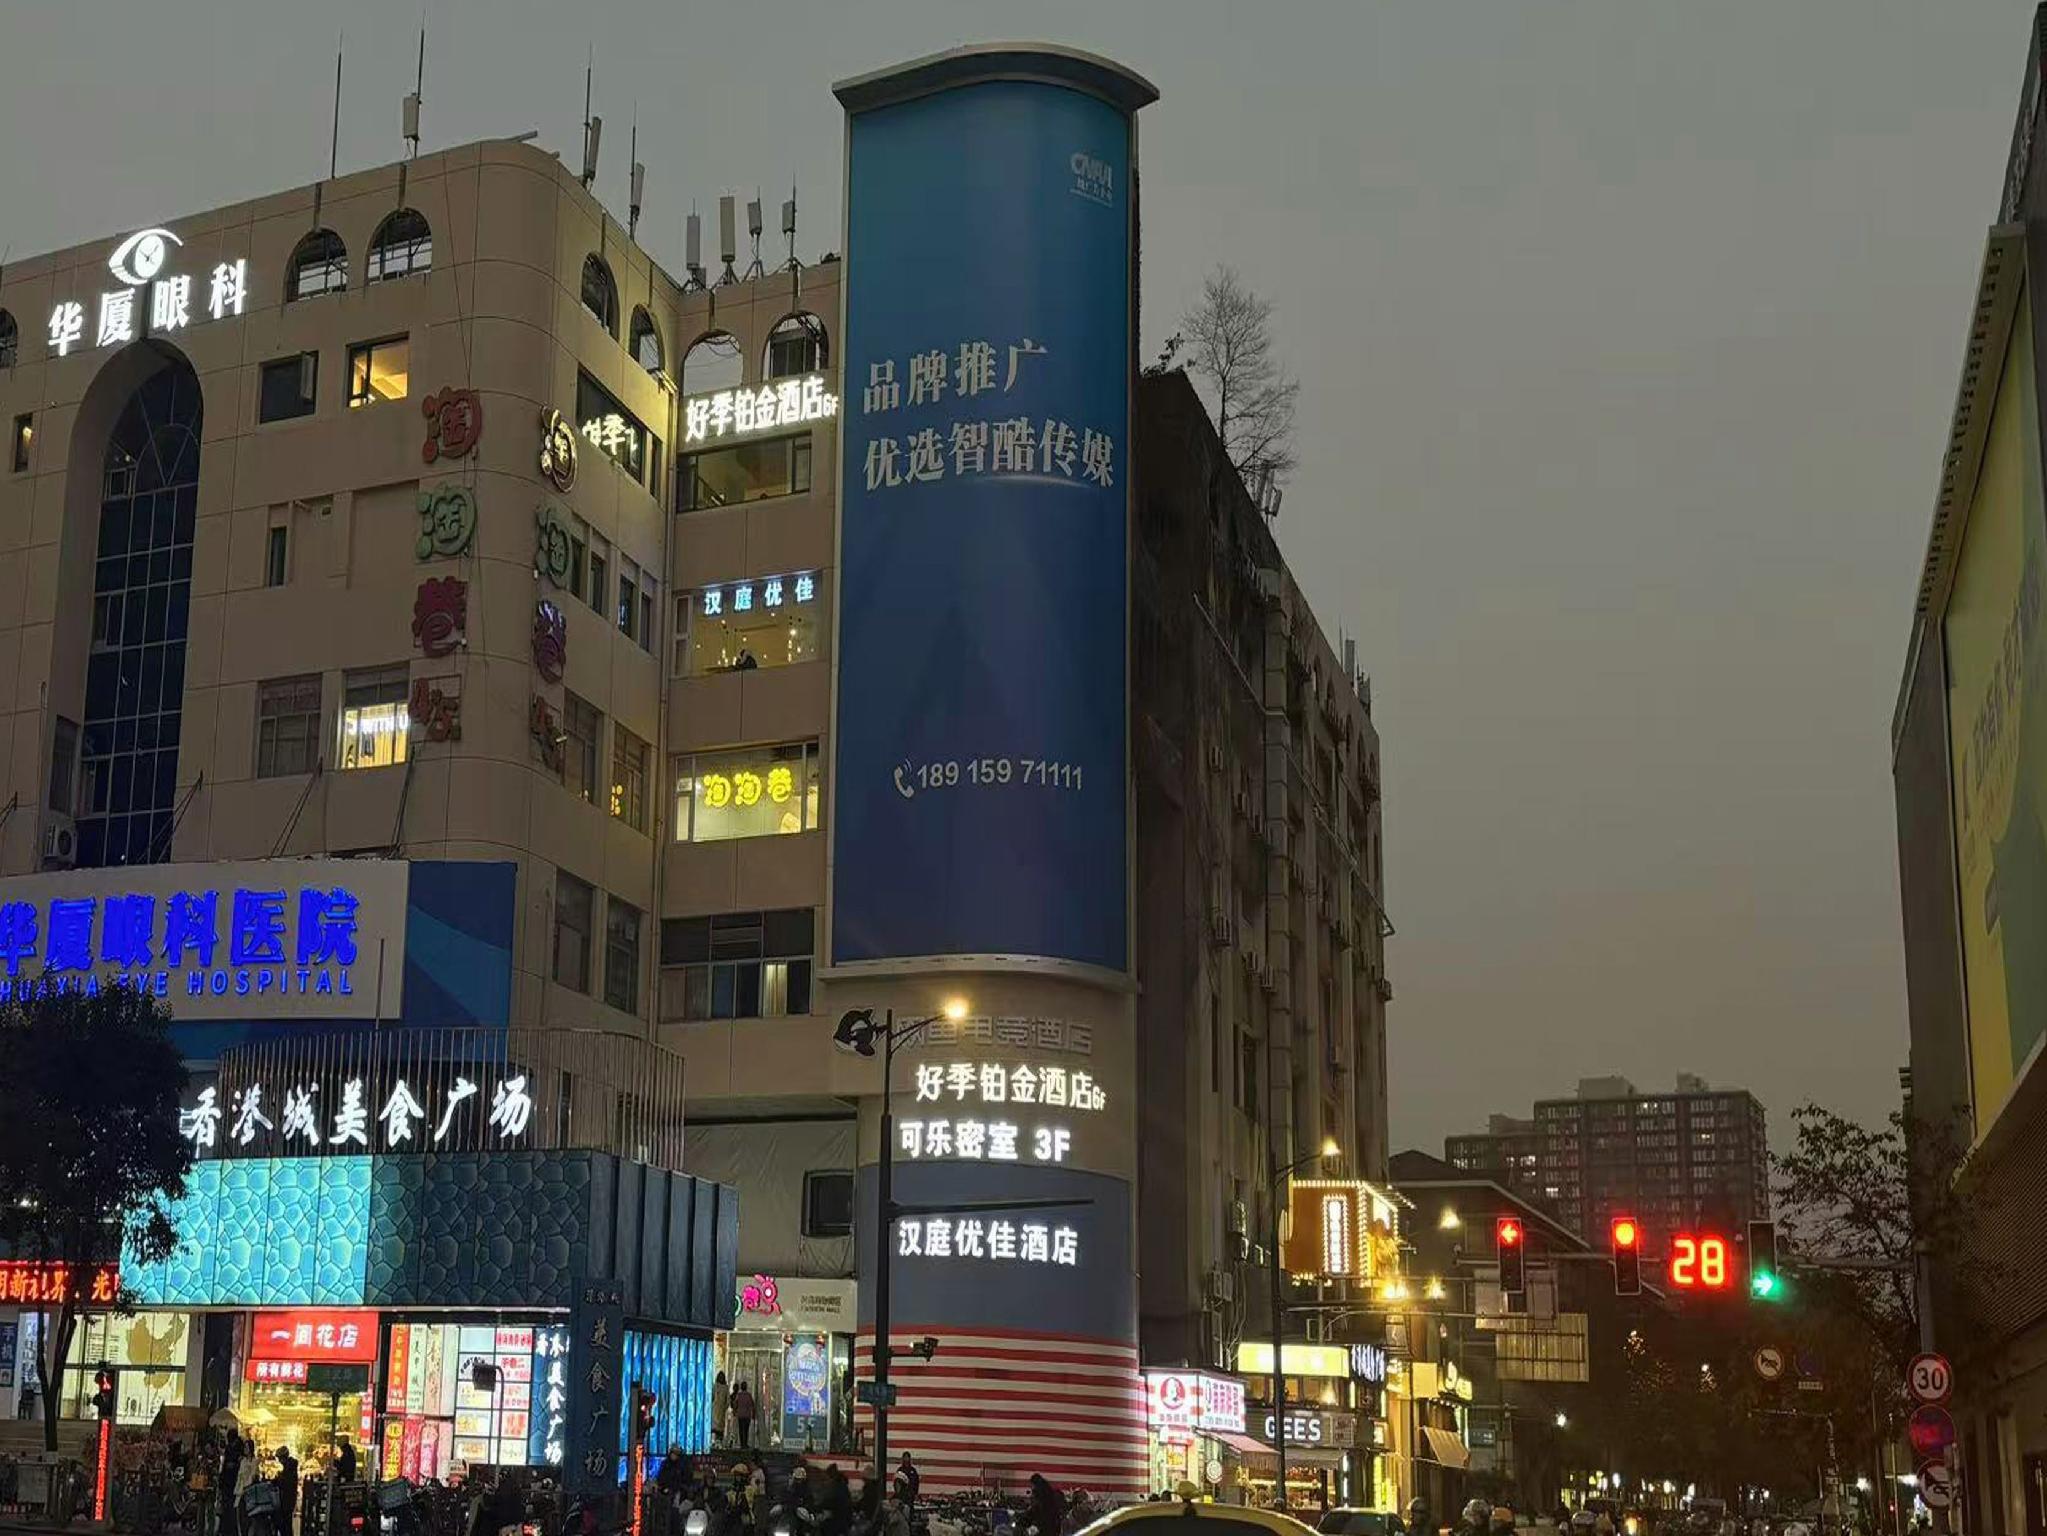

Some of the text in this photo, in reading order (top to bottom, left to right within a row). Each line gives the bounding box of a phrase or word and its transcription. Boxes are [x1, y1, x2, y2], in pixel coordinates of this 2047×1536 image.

[48, 258, 249, 357] 华厦眼科
[863, 338, 1048, 414] 品牌推广
[864, 416, 1114, 491] 优选智酷传媒
[704, 576, 814, 615] 汉庭优佳
[917, 758, 1083, 790] 189 159 71111
[188, 969, 353, 996] HOSPITAL
[192, 1076, 532, 1147] 香港城美食广场
[899, 1119, 1071, 1162] 可乐密室 3F
[899, 1219, 1078, 1266] 汉庭优佳酒店
[1673, 1238, 1726, 1286] 28
[1916, 1367, 1945, 1390] 30
